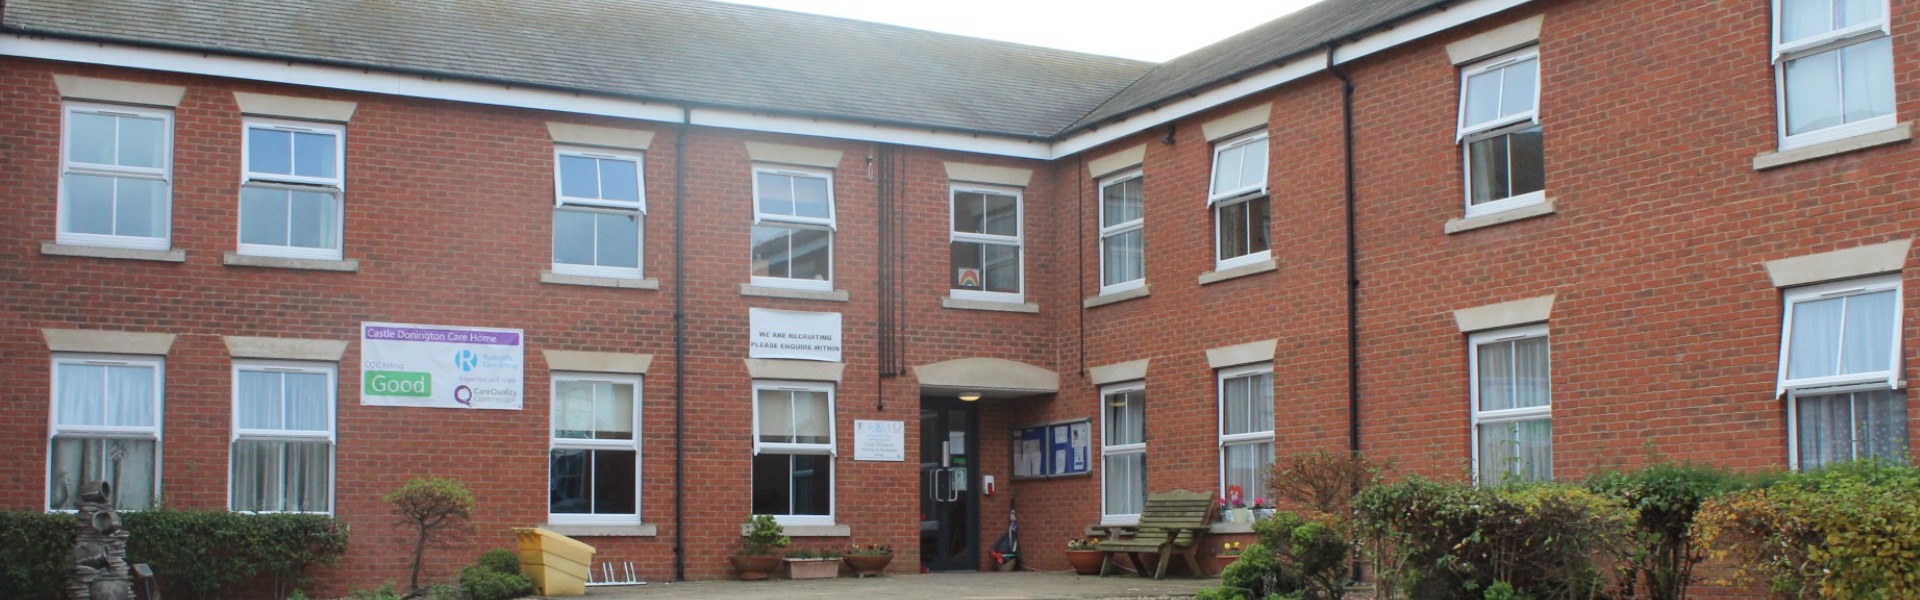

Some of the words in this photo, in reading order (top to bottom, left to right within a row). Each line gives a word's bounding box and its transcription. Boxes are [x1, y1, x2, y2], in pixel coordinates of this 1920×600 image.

[367, 328, 395, 338] Castle
[397, 330, 445, 342] Donington
[447, 332, 467, 341] Care
[470, 333, 497, 343] Home
[788, 333, 832, 341] RECRUITING
[751, 341, 778, 349] PLEASE
[780, 343, 812, 351] ENQUIRE
[365, 360, 382, 369] CQC
[372, 374, 425, 393] Good
